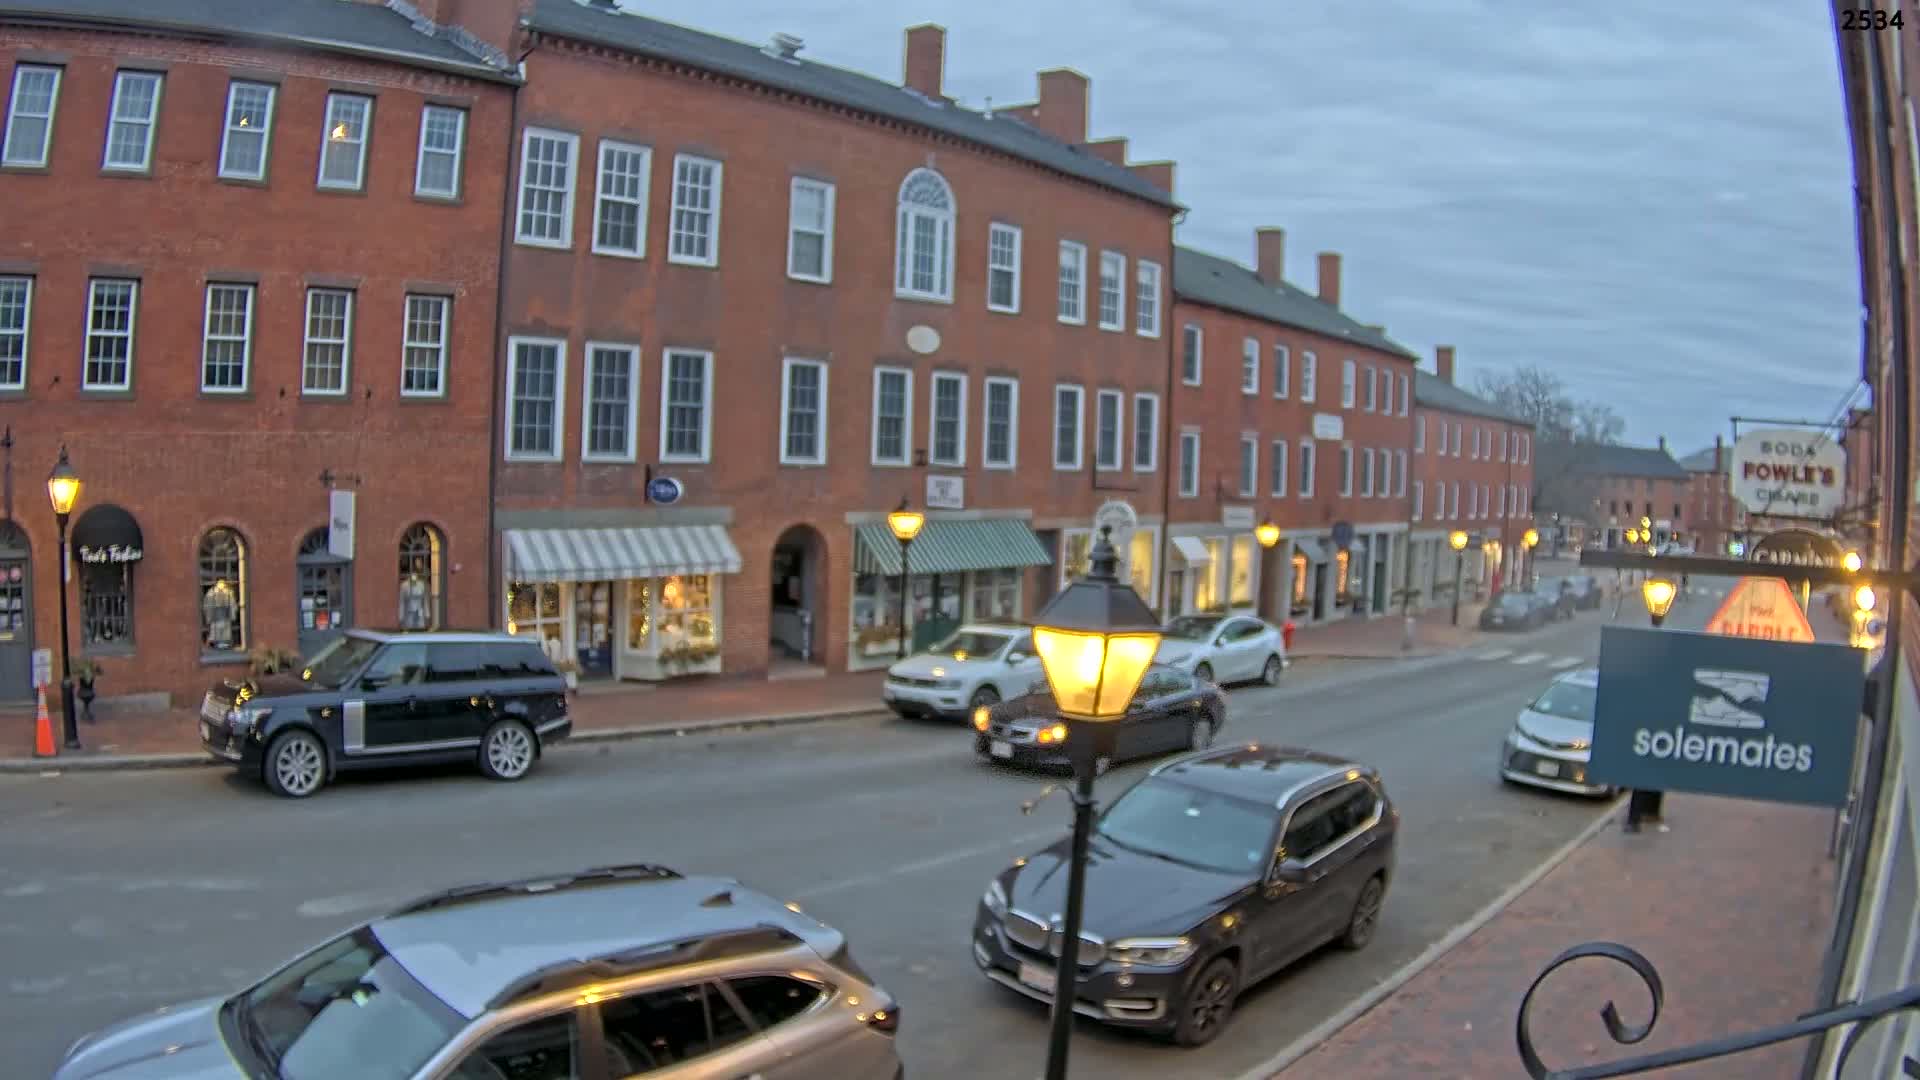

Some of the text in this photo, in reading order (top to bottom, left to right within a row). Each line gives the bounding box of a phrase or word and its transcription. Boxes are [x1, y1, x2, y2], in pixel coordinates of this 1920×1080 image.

[1761, 441, 1816, 457] SODA
[1744, 461, 1835, 487] FOWLE'S
[1633, 725, 1813, 772] solemates
